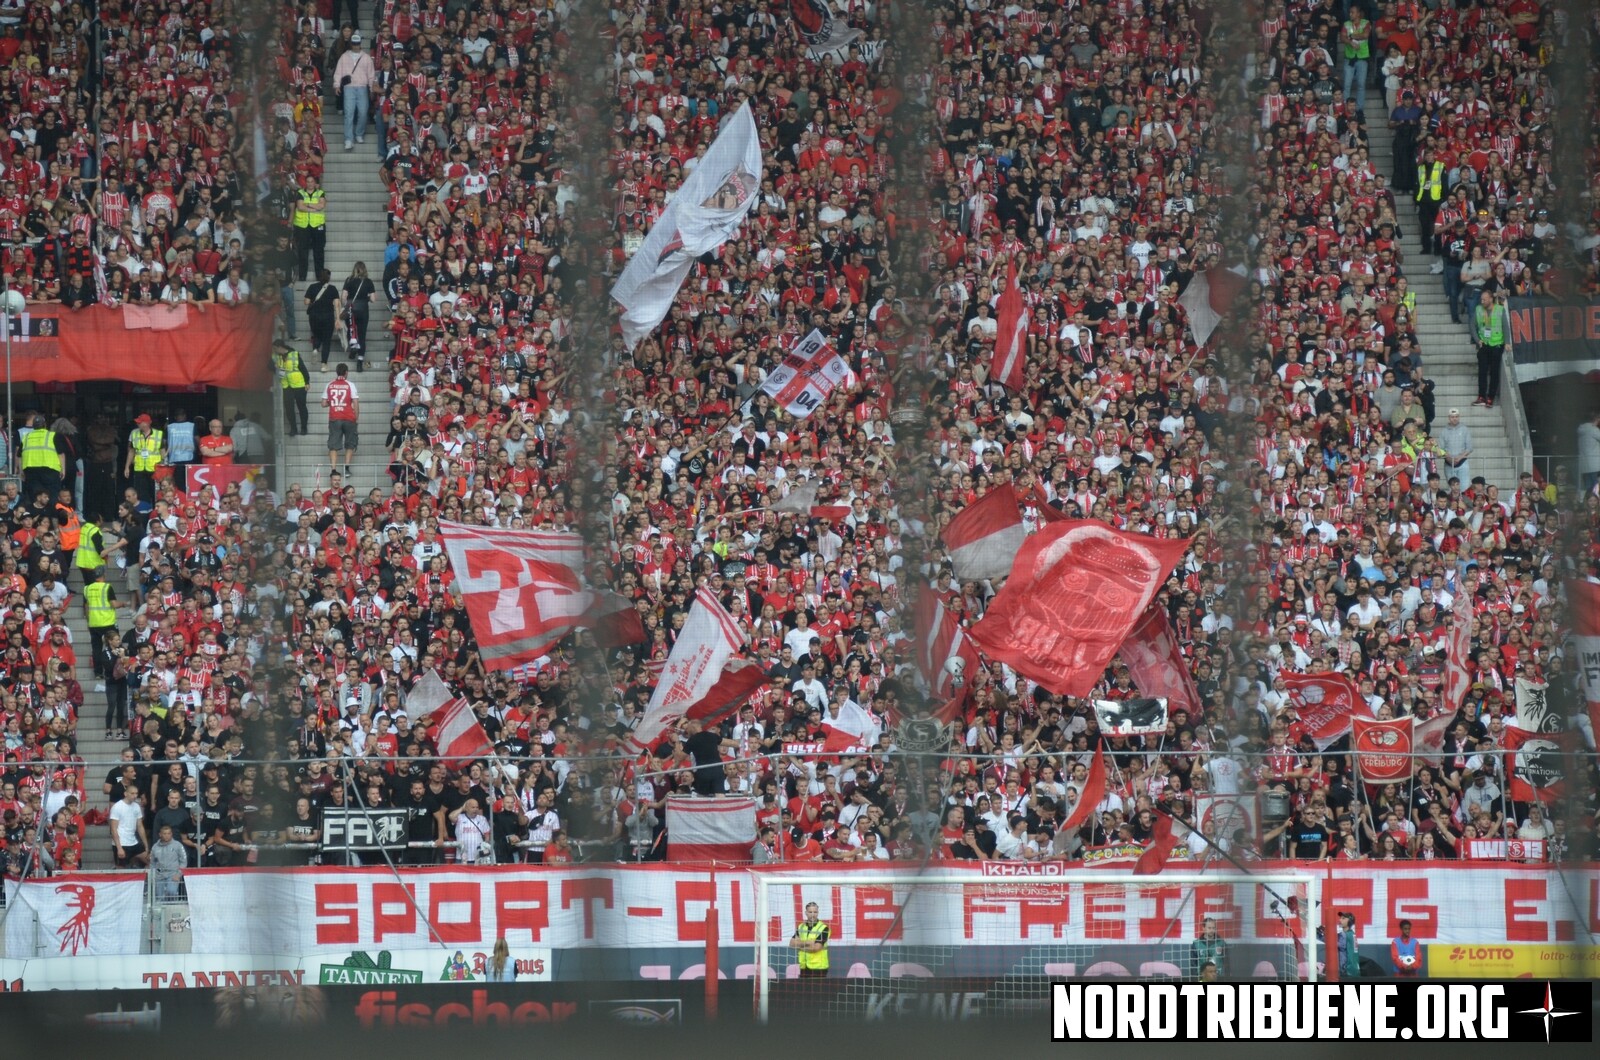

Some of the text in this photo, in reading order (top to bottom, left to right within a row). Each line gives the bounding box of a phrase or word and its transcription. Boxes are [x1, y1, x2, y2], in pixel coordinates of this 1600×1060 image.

[1511, 306, 1600, 343] NIEDE
[801, 341, 820, 355] 19
[330, 389, 347, 407] 32
[795, 391, 819, 411] 04
[1364, 758, 1403, 767] FREIBURG
[1518, 767, 1561, 776] INTRNATIONAL
[988, 864, 1059, 876] KHALID
[315, 878, 904, 944] SPORT-CLUB
[963, 878, 1438, 940] FREIBURG
[1468, 948, 1514, 960] LOTTO
[324, 968, 418, 985] TANNEN
[355, 989, 577, 1028] fischer
